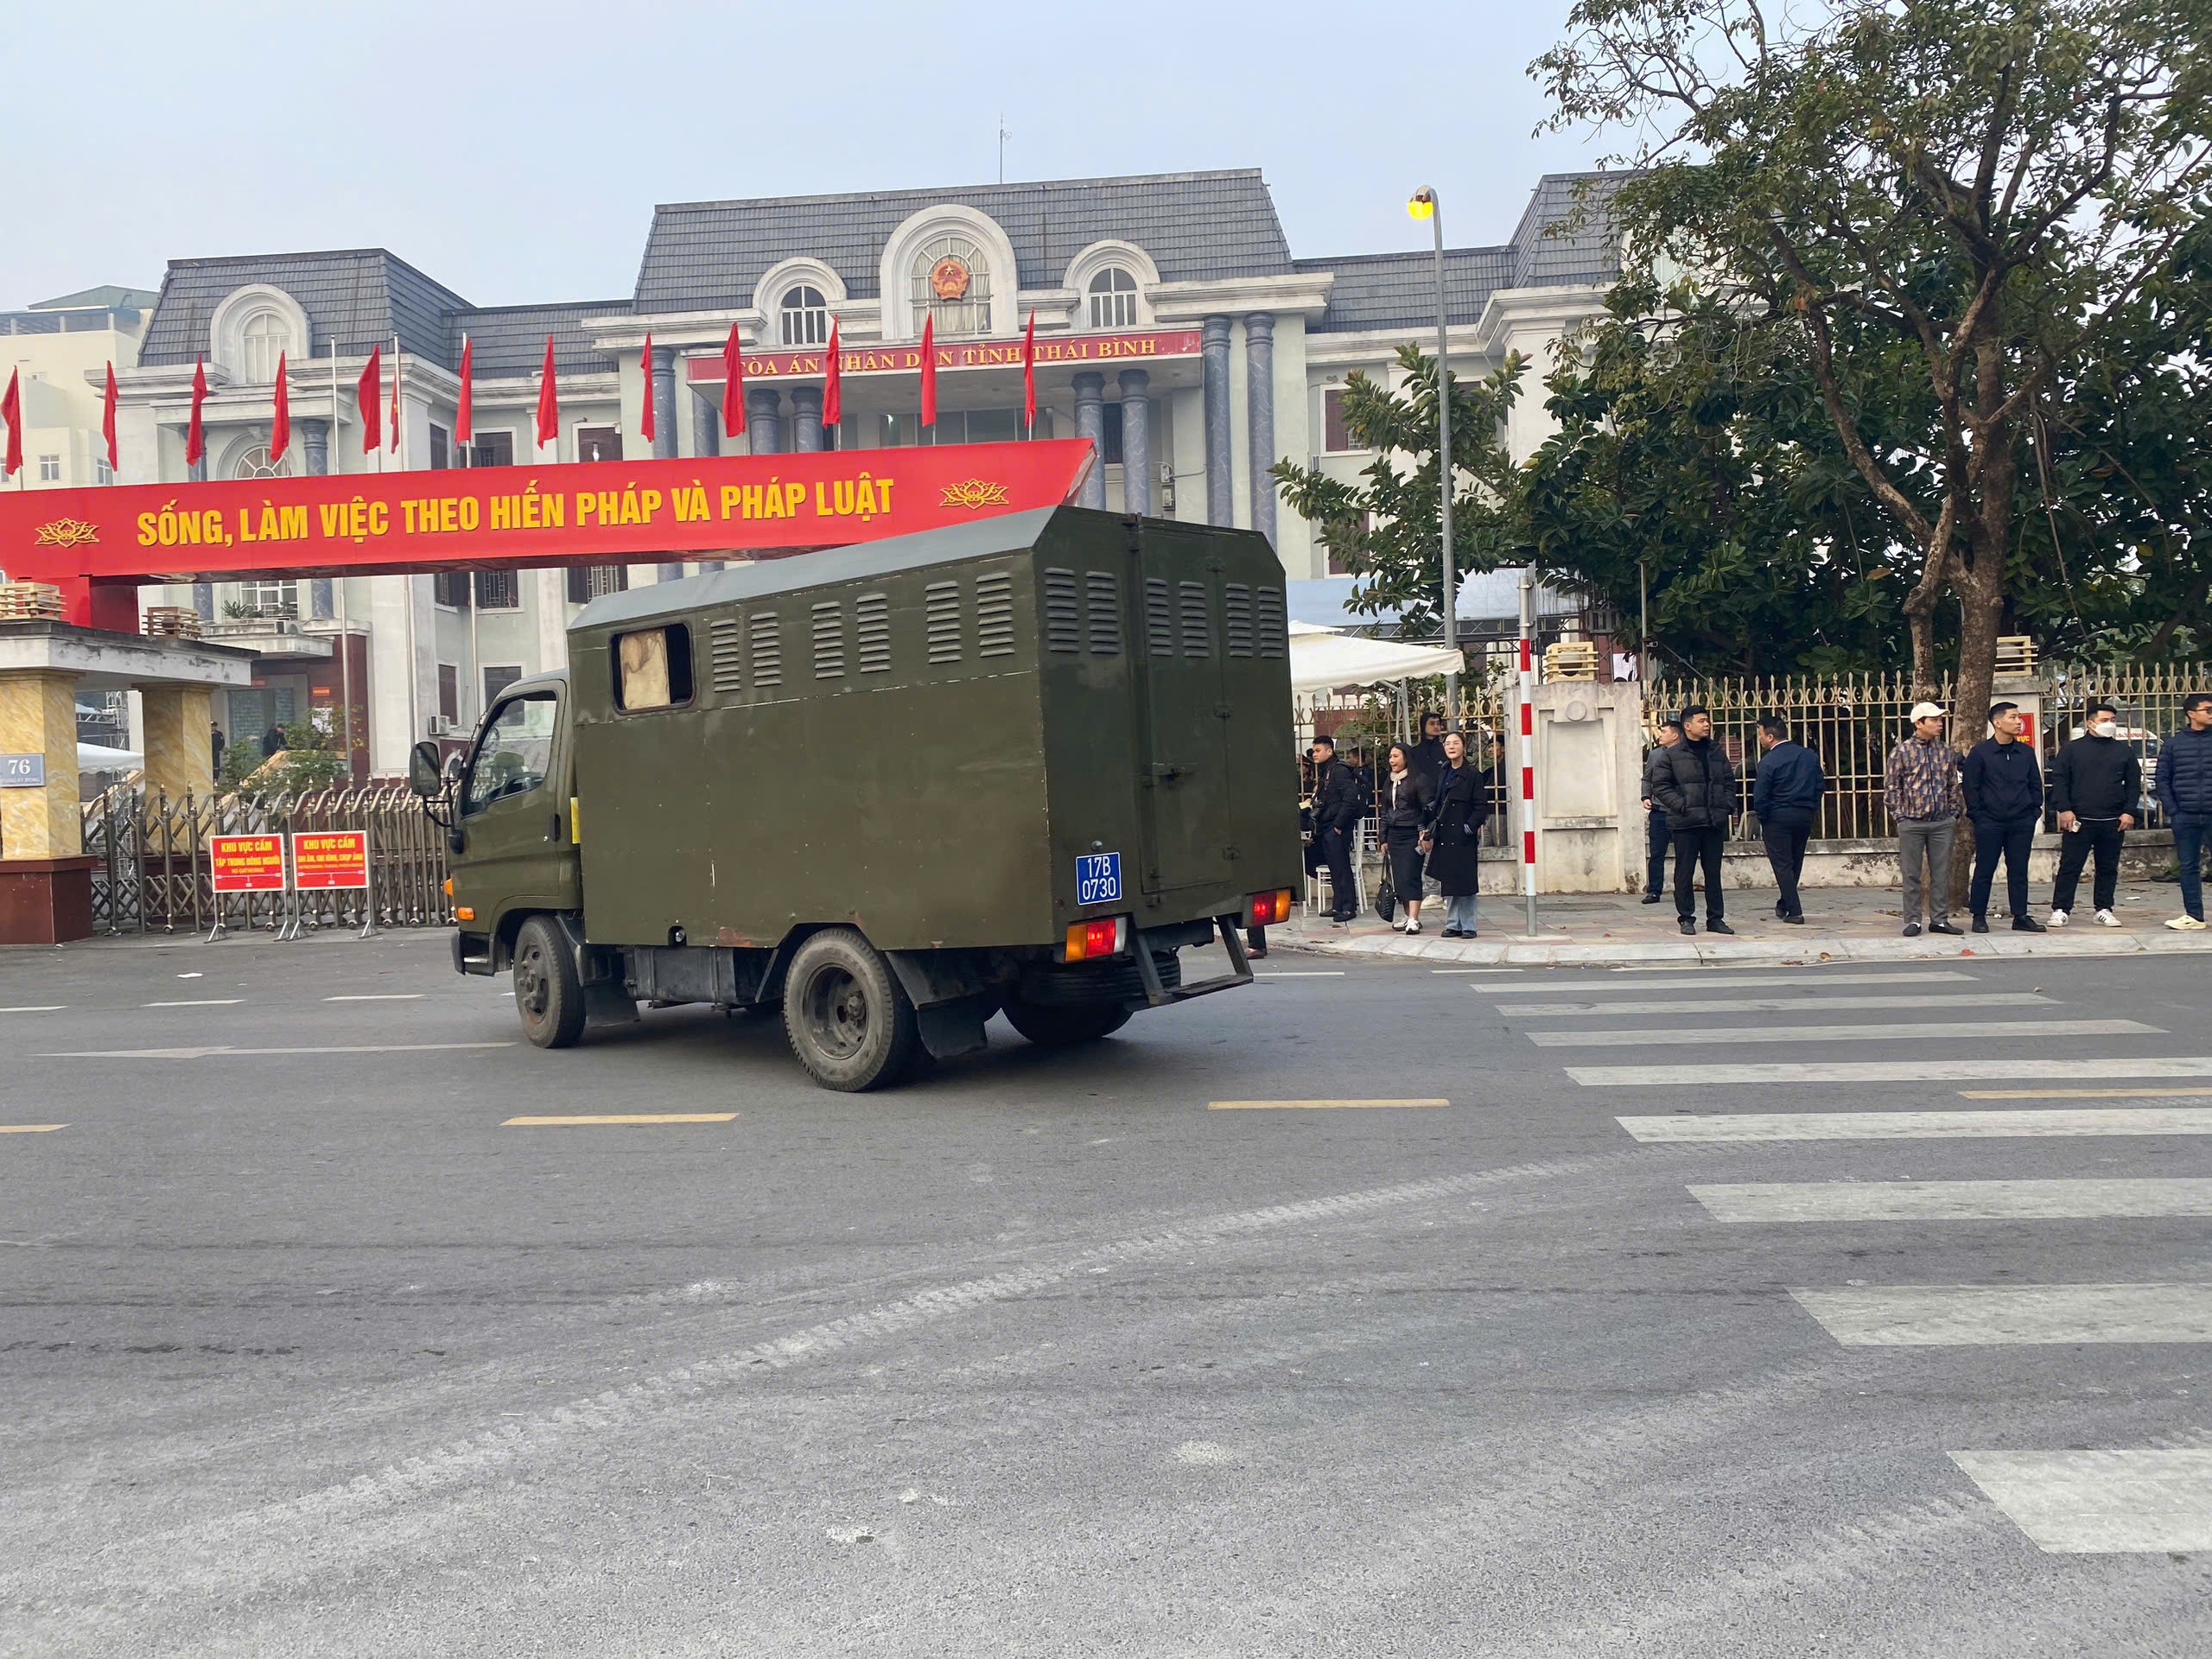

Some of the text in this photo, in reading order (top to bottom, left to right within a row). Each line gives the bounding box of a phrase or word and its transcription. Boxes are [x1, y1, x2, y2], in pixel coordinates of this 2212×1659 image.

[787, 354, 820, 374] ÁN
[904, 351, 954, 367] DN
[963, 343, 1023, 365] TỈNH
[1033, 340, 1089, 361] THÁI
[1097, 337, 1157, 358] BÌNH
[137, 471, 894, 547] SỐNG, LÀM VIỆC THEO HIẾN PHÁP VÀ PHÁP LUẬT
[8, 759, 31, 775] 76
[221, 838, 273, 854] KHU VỰC CẤM
[303, 836, 356, 851] KHU VỰC CẤM
[1087, 855, 1111, 878] 17B
[1083, 876, 1116, 900] 0730
